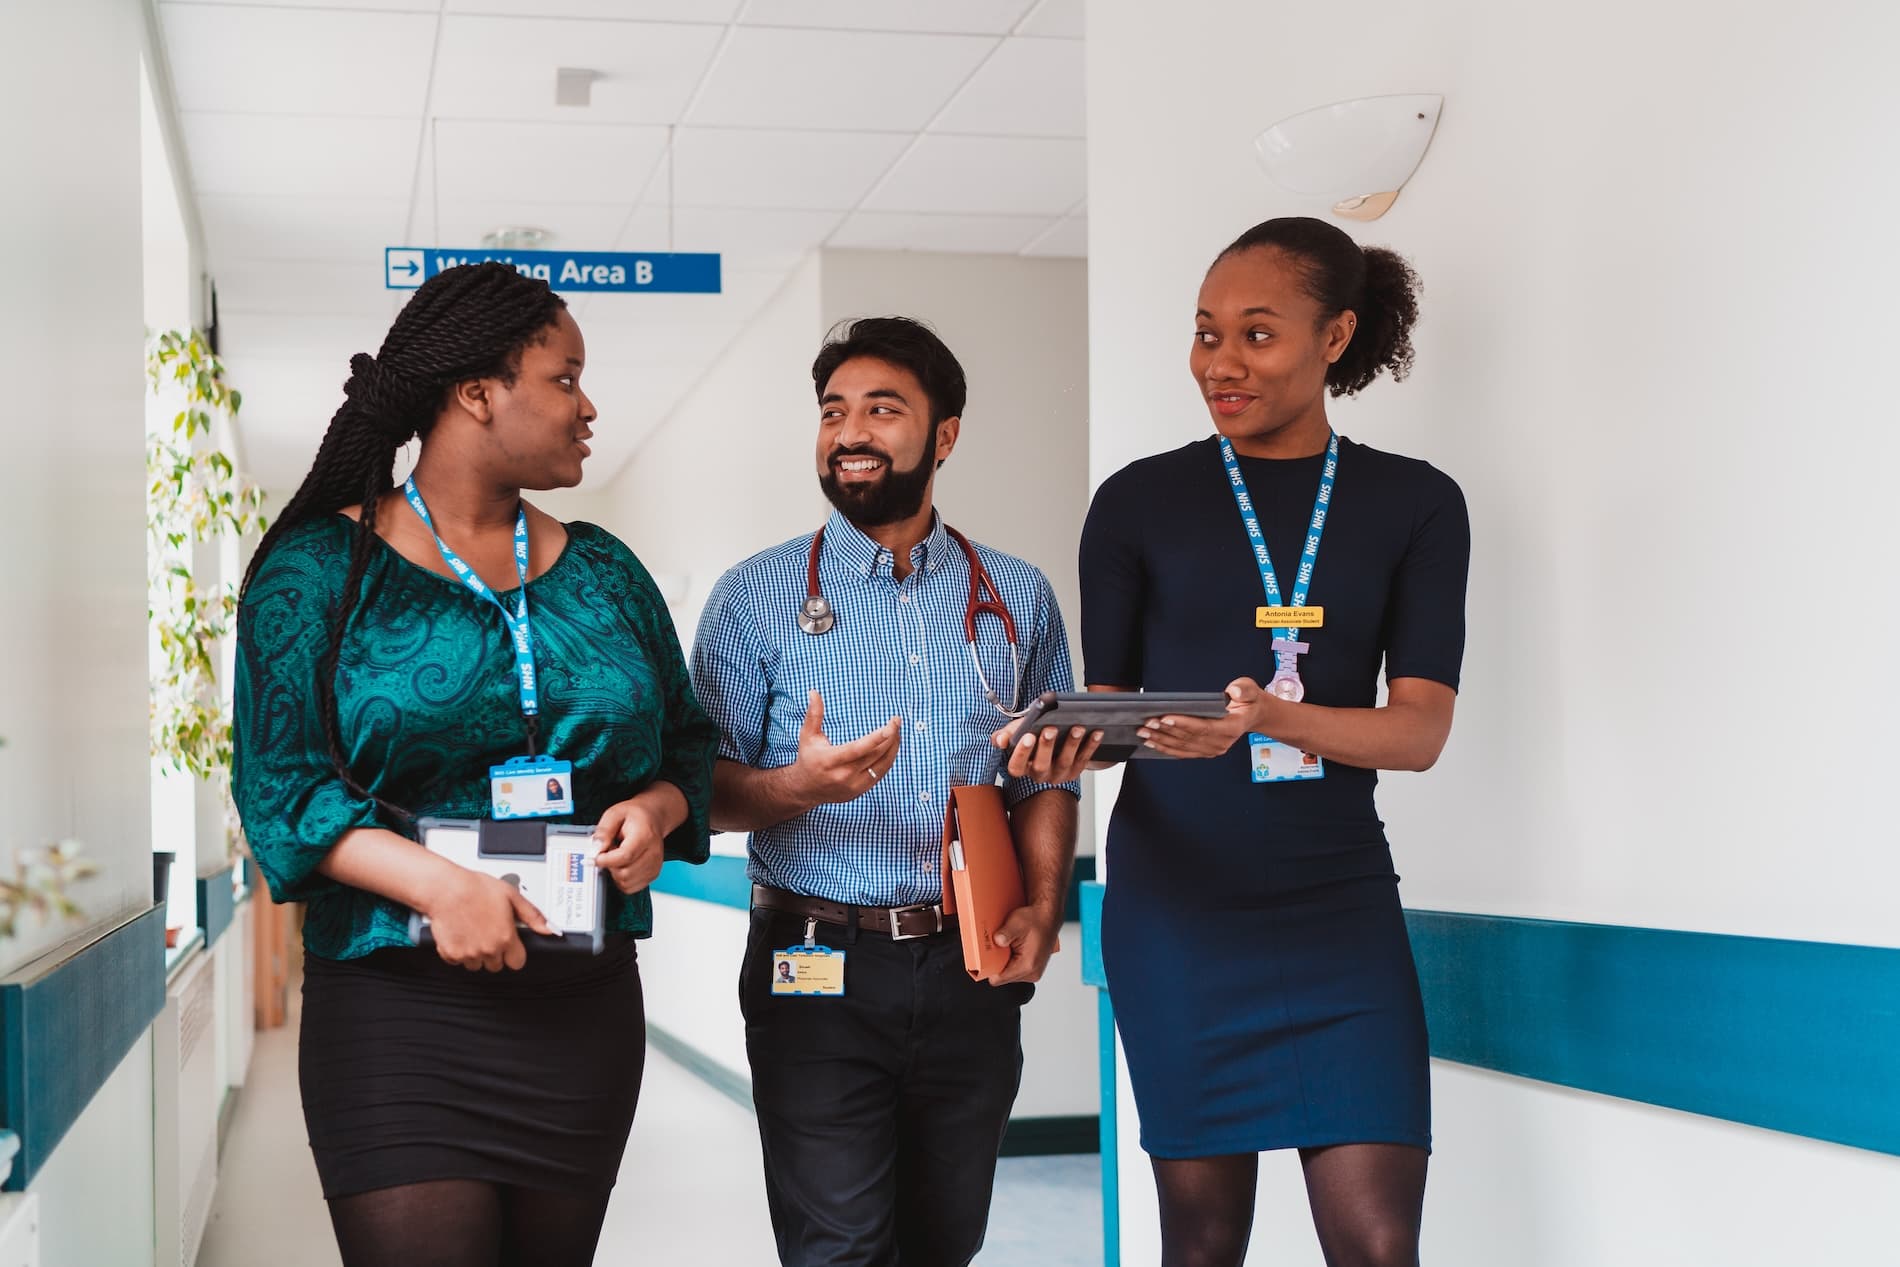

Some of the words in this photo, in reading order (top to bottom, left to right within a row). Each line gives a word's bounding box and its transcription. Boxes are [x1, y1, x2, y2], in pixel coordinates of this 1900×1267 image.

[559, 259, 626, 284] Area
[635, 260, 654, 285] B
[1222, 445, 1235, 462] NHS
[1228, 467, 1243, 486] NHS
[1325, 459, 1336, 479] NHS
[1237, 492, 1252, 512] NHS
[1319, 483, 1331, 504] NHS
[1246, 518, 1261, 538] NHS
[1312, 509, 1326, 529] NHS
[515, 541, 527, 560] NHS
[1254, 544, 1270, 565] NHS
[1305, 535, 1319, 556] NHS
[1264, 571, 1278, 595] NHS
[1298, 562, 1312, 585] NHS
[1293, 592, 1305, 608] HS
[521, 663, 534, 690] NHS
[570, 854, 579, 881] HYMS
